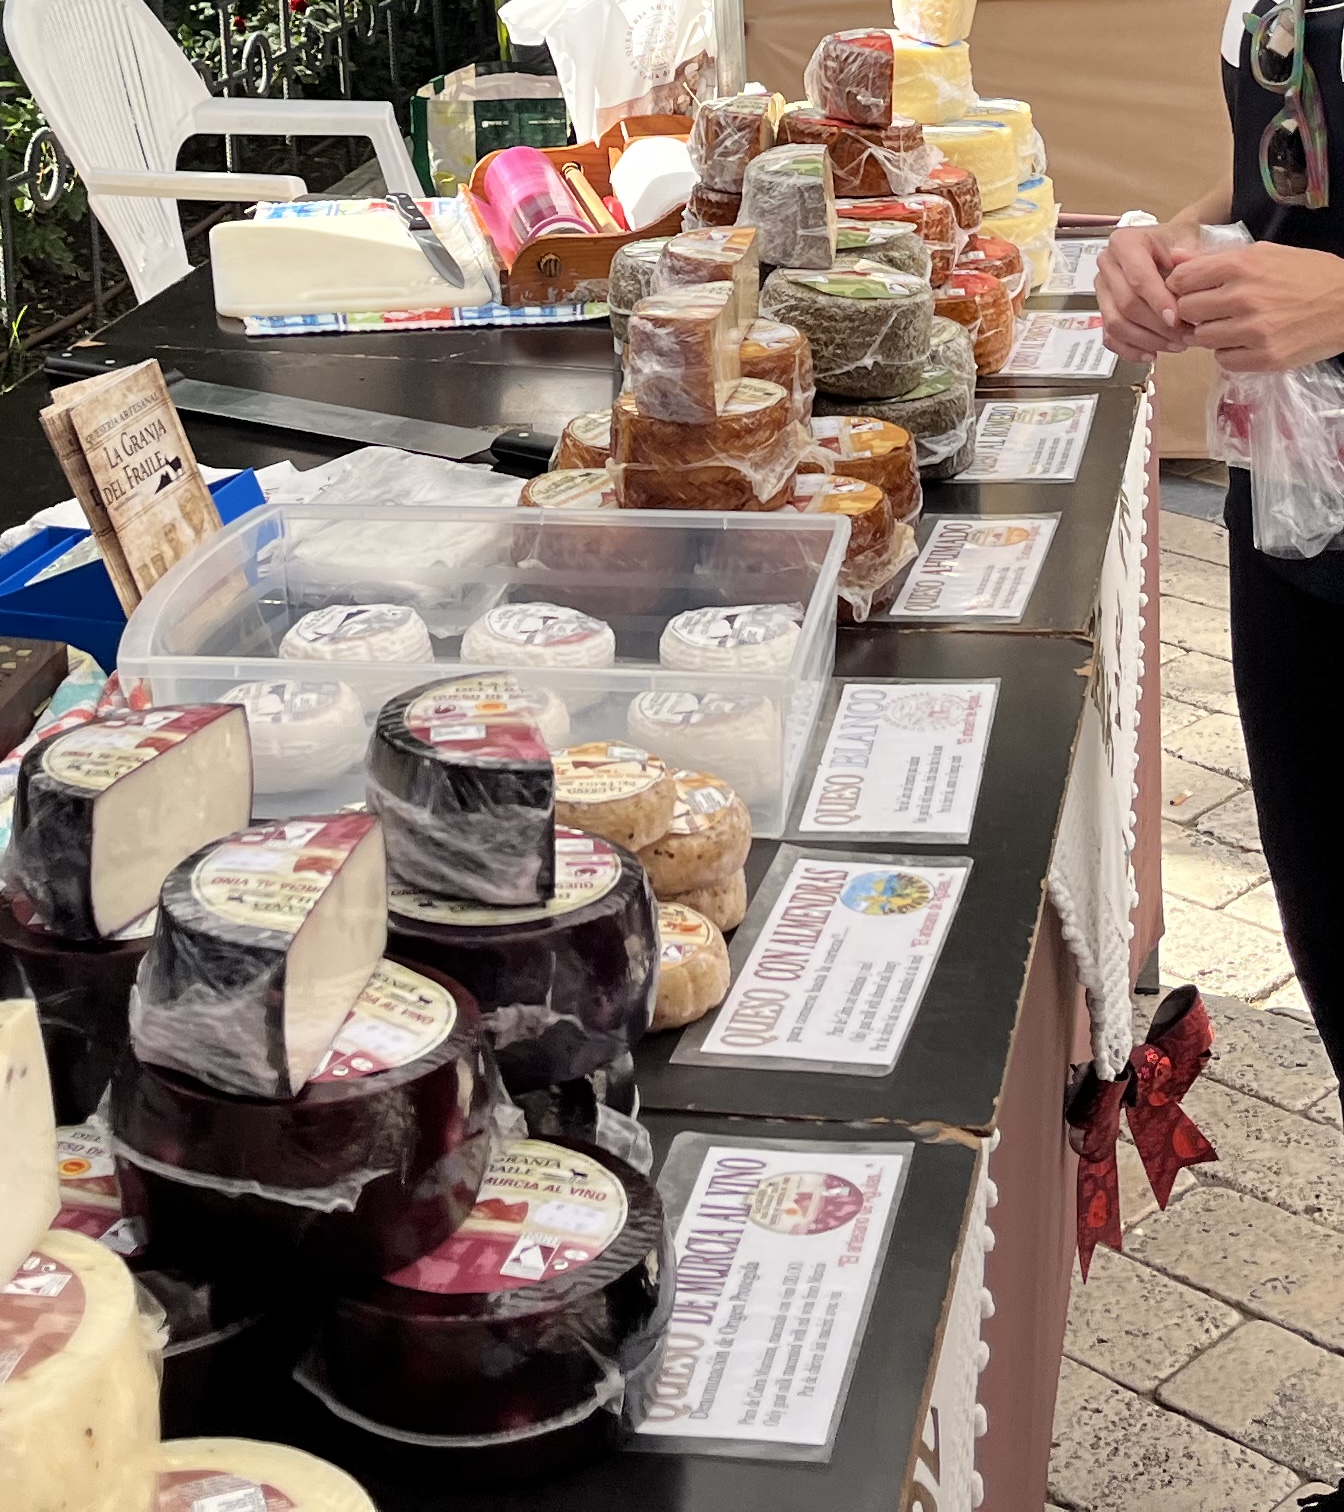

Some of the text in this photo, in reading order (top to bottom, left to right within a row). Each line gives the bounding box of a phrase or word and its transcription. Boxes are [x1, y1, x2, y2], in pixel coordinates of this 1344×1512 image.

[104, 418, 167, 470] LA GRANJA
[104, 451, 168, 506] DEL FRAILE
[902, 523, 975, 611] QUESO AHUMADO
[813, 689, 887, 825] QUESO BLANCO
[720, 867, 851, 1047] QUESO CON ALMENDRAS
[544, 1184, 563, 1194] AL
[570, 1186, 607, 1201] VINO
[646, 1157, 767, 1422] QUESO DE MURCIA AL VINO
